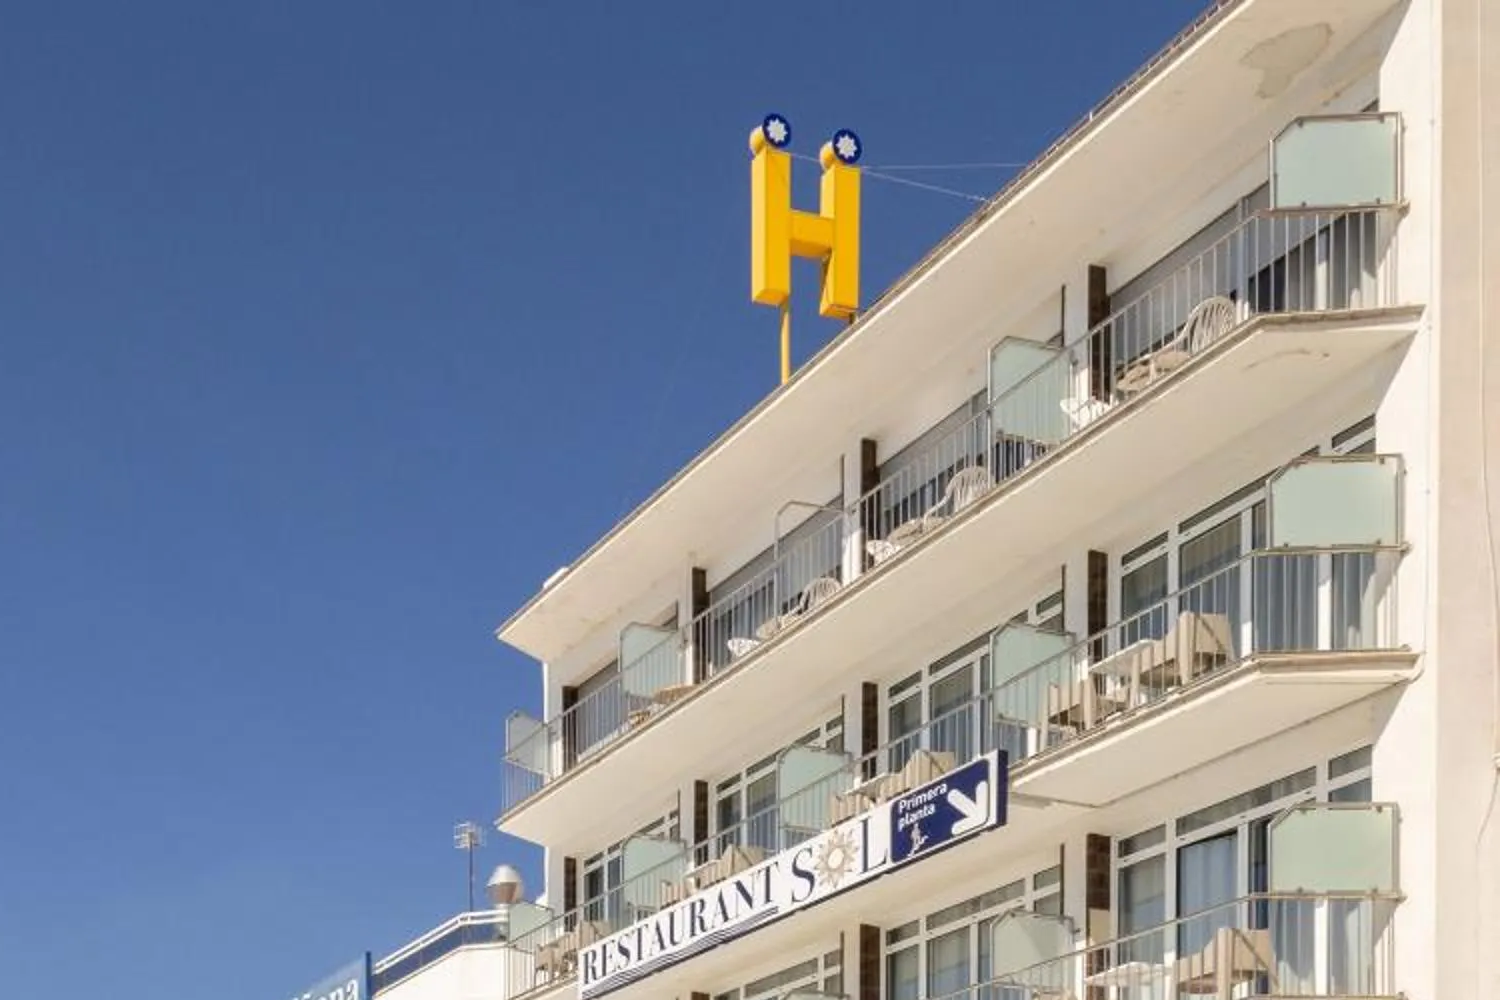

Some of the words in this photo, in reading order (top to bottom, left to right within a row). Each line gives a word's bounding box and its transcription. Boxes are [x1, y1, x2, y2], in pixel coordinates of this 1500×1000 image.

[751, 149, 860, 317] H
[898, 783, 948, 815] Primera
[898, 803, 936, 832] planta
[583, 861, 780, 985] RESTAURANT
